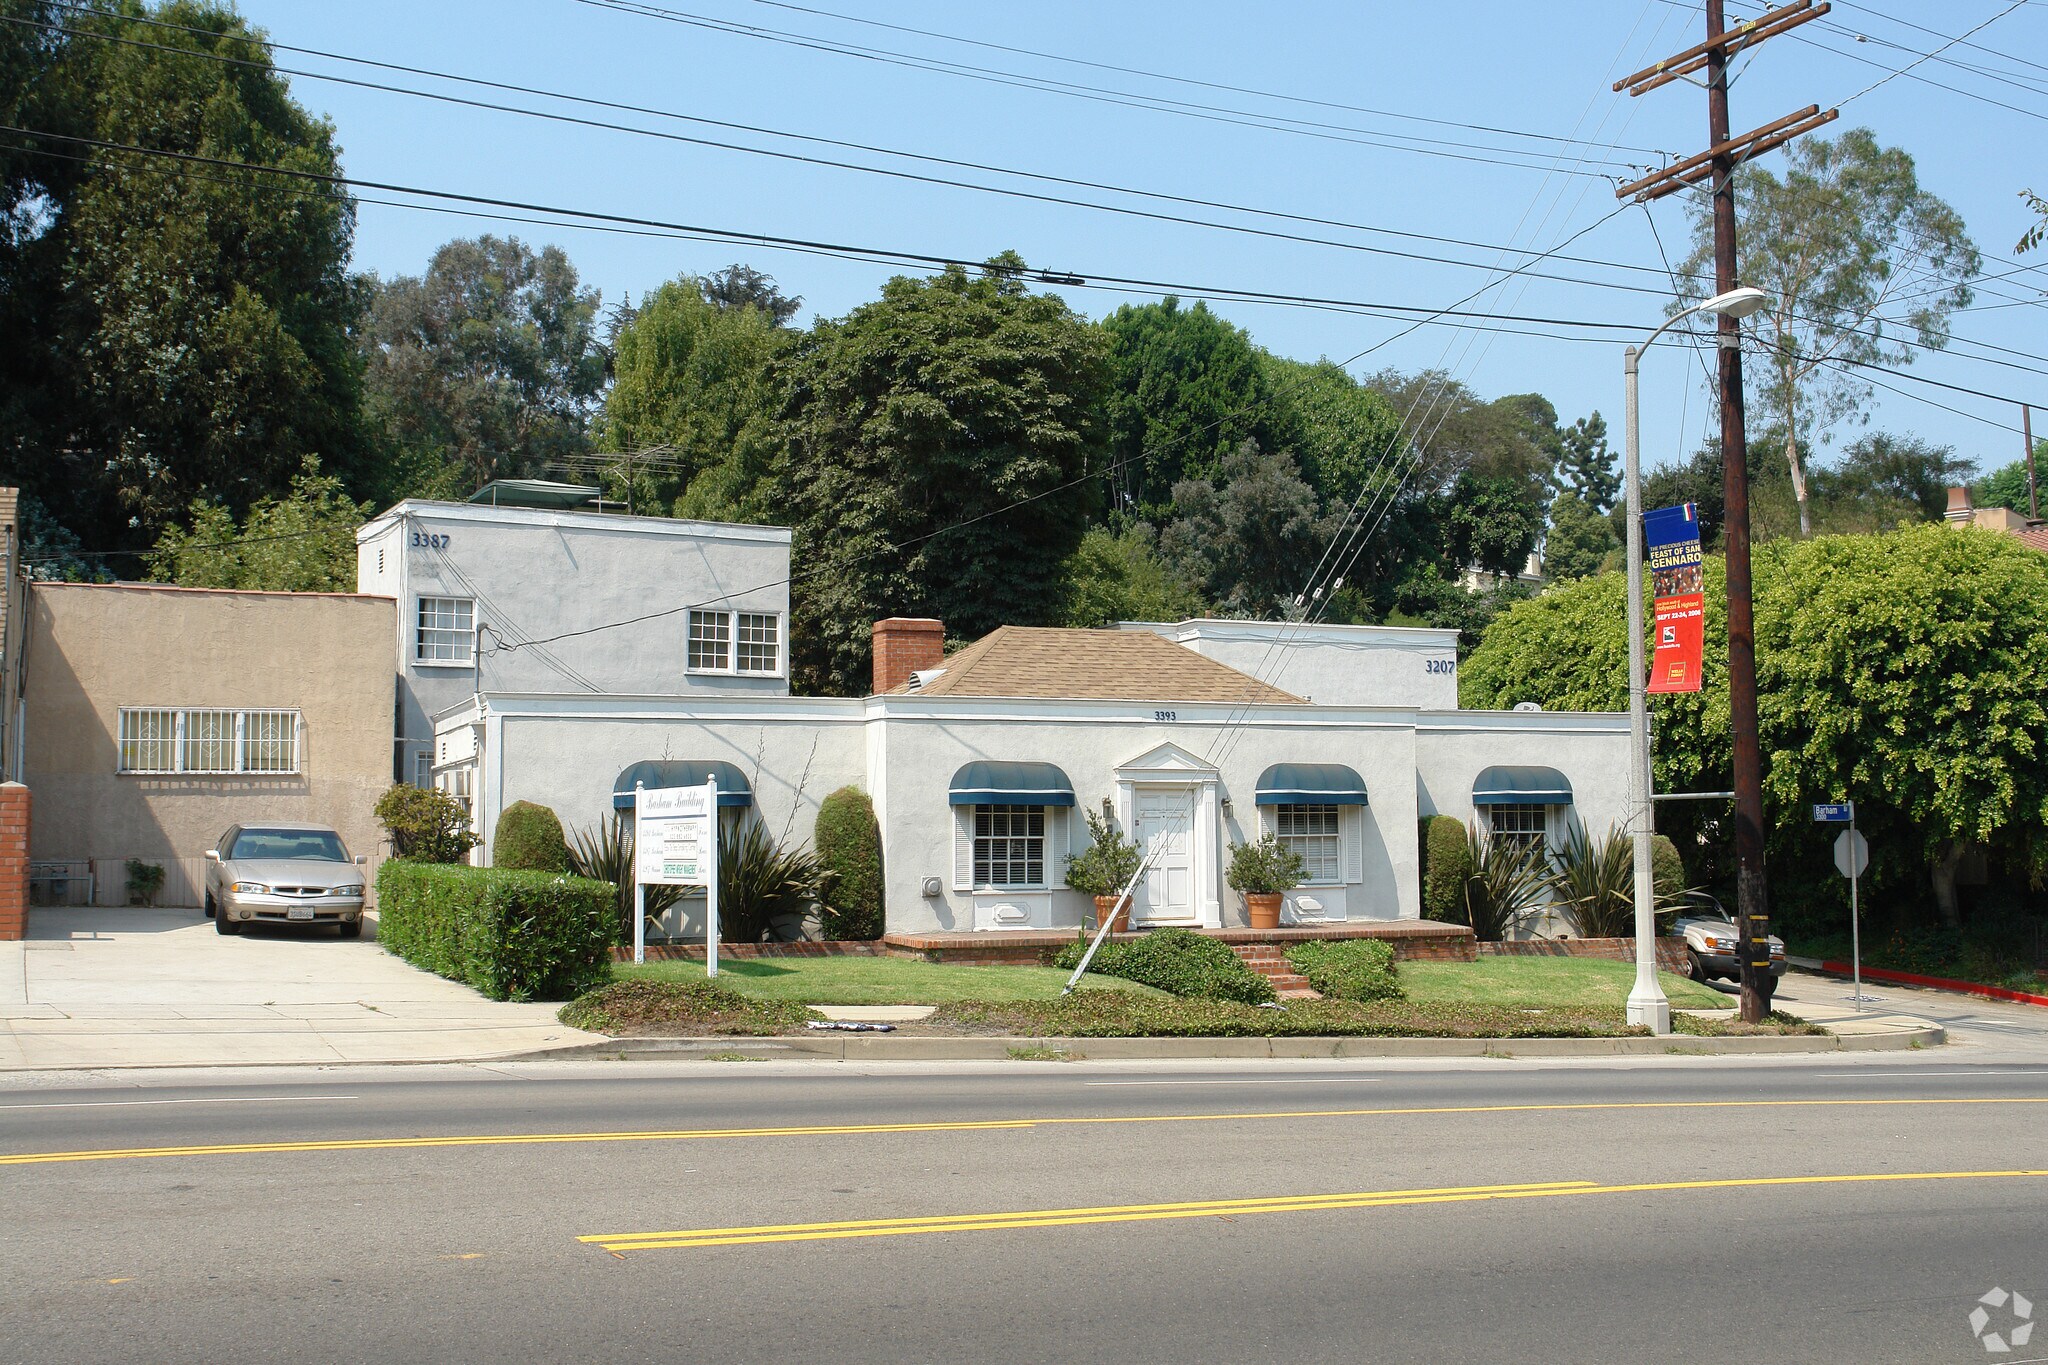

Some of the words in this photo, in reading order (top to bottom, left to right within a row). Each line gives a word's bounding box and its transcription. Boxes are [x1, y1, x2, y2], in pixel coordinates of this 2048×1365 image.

[412, 532, 450, 549] 3387
[1660, 542, 1682, 550] PRECIOUS
[1682, 539, 1700, 547] CHEESE
[1650, 549, 1673, 560] FEAST
[1674, 547, 1684, 556] OF
[1685, 545, 1701, 554] SAN
[1651, 552, 1701, 569] GENNARO
[1656, 603, 1677, 612] Hollywood
[1681, 601, 1699, 609] Highland
[1657, 613, 1671, 621] SEPT
[1426, 660, 1456, 673] 3207
[1154, 711, 1176, 721] 3393
[675, 791, 704, 812] Building
[1816, 806, 1837, 814] Barham
